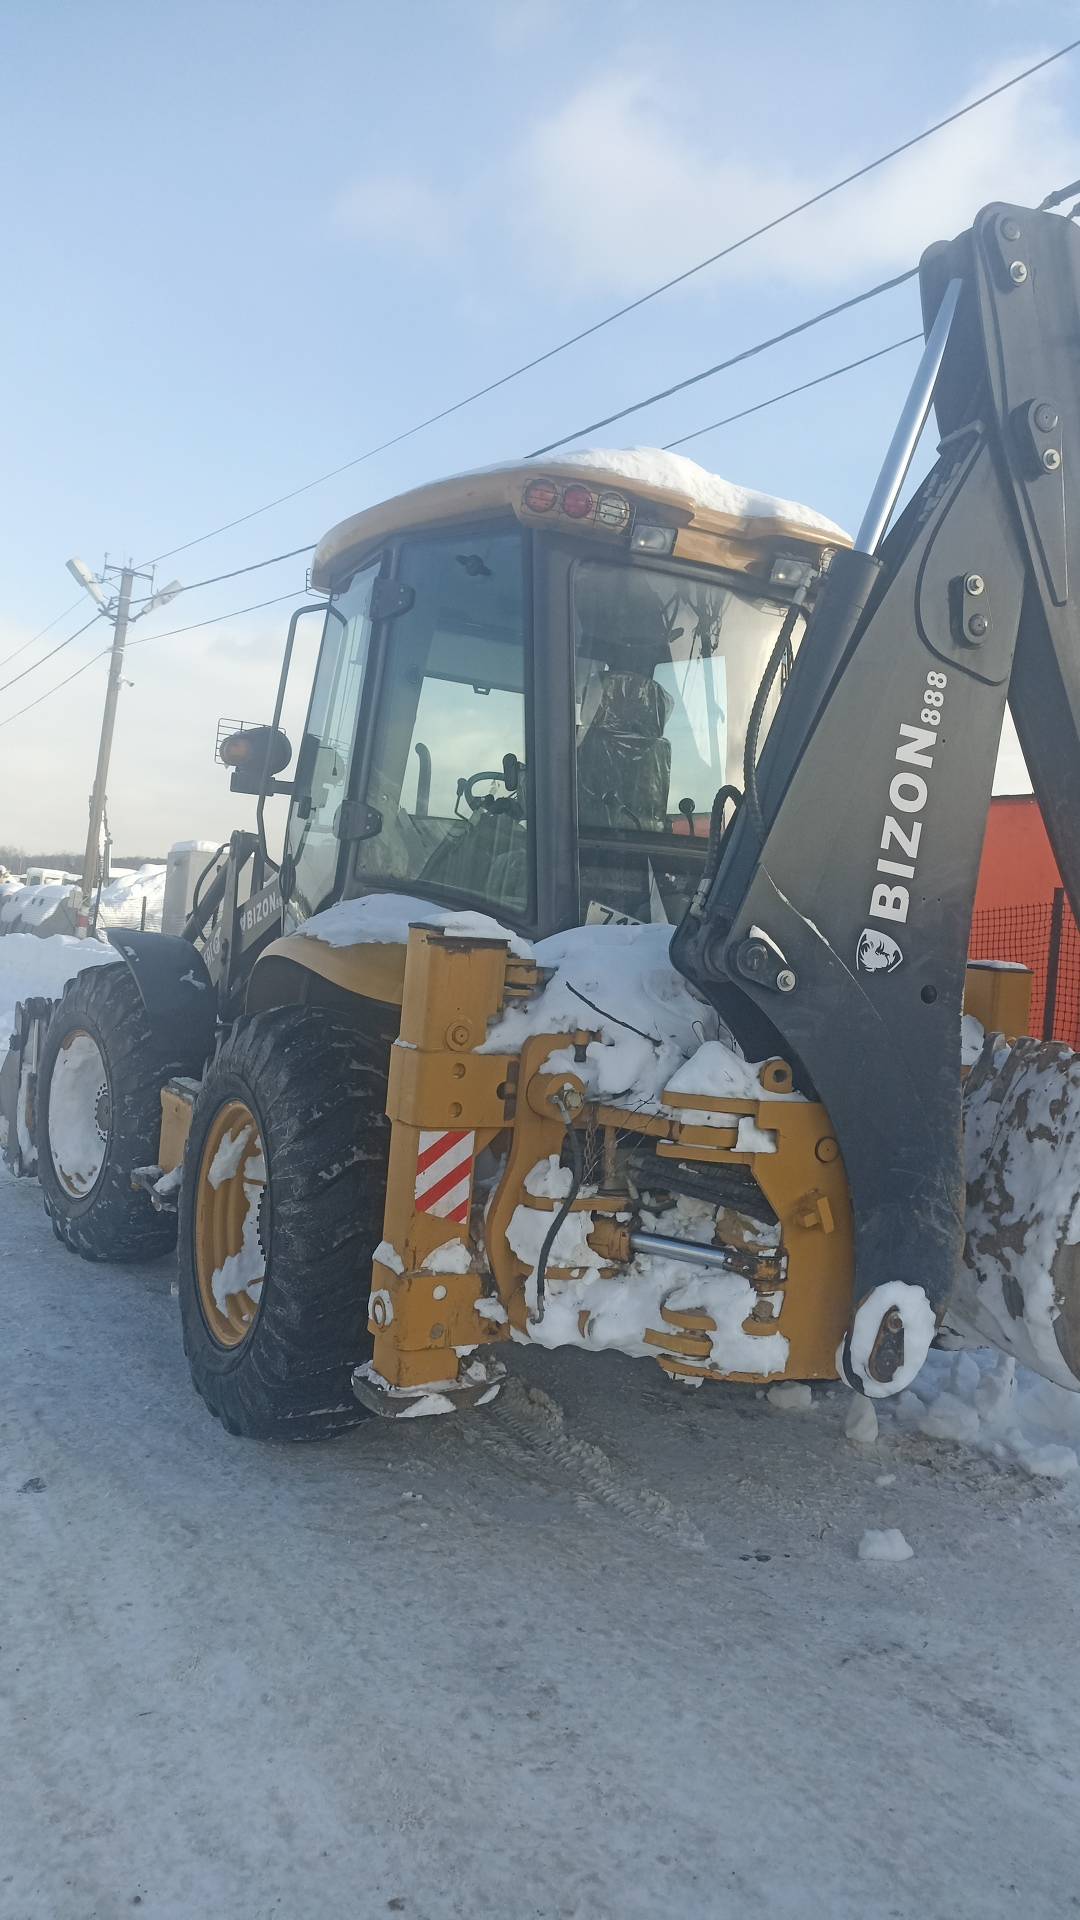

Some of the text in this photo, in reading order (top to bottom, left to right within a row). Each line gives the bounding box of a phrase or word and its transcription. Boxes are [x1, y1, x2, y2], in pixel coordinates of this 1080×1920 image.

[869, 670, 947, 923] BIZON 888
[247, 891, 277, 930] BIZON
